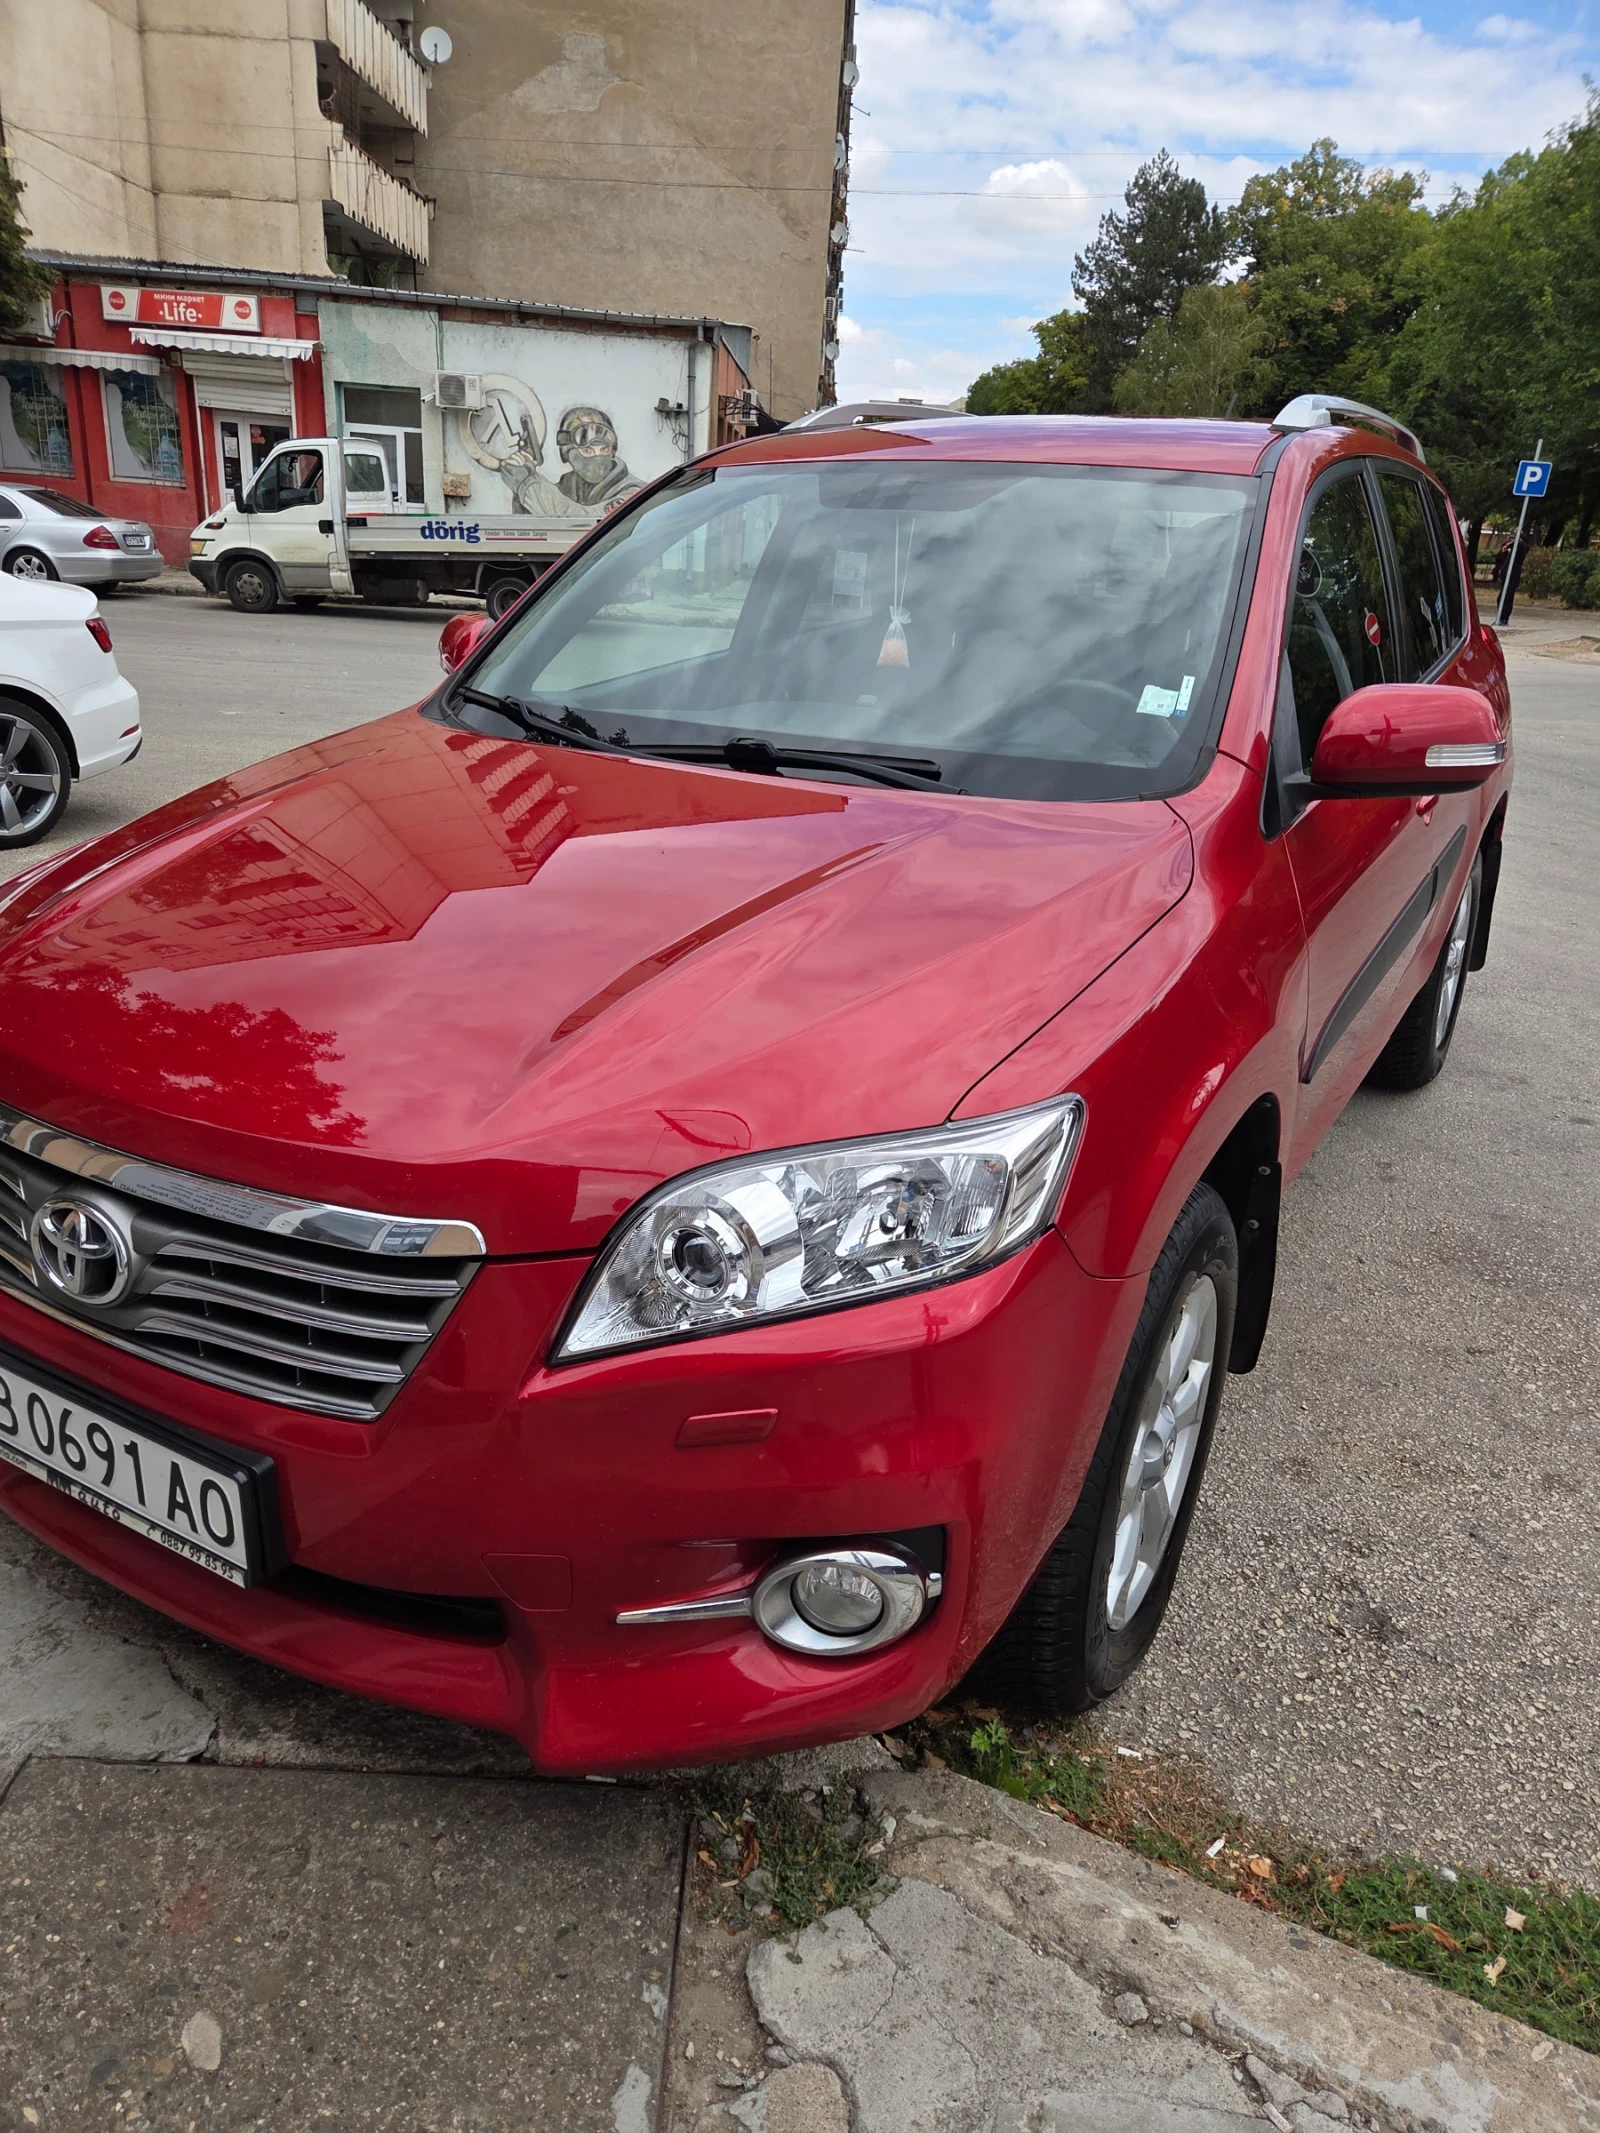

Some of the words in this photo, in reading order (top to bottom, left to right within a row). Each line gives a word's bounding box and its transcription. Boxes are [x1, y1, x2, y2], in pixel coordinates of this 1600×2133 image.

[153, 292, 176, 301] мини
[176, 294, 205, 304] маркет
[1521, 465, 1543, 491] P
[420, 521, 481, 543] dörig
[77, 1488, 121, 1523] auto
[160, 1531, 187, 1554] 0887
[188, 1544, 202, 1562] 99
[204, 1555, 218, 1571] 85
[220, 1560, 235, 1580] 95
